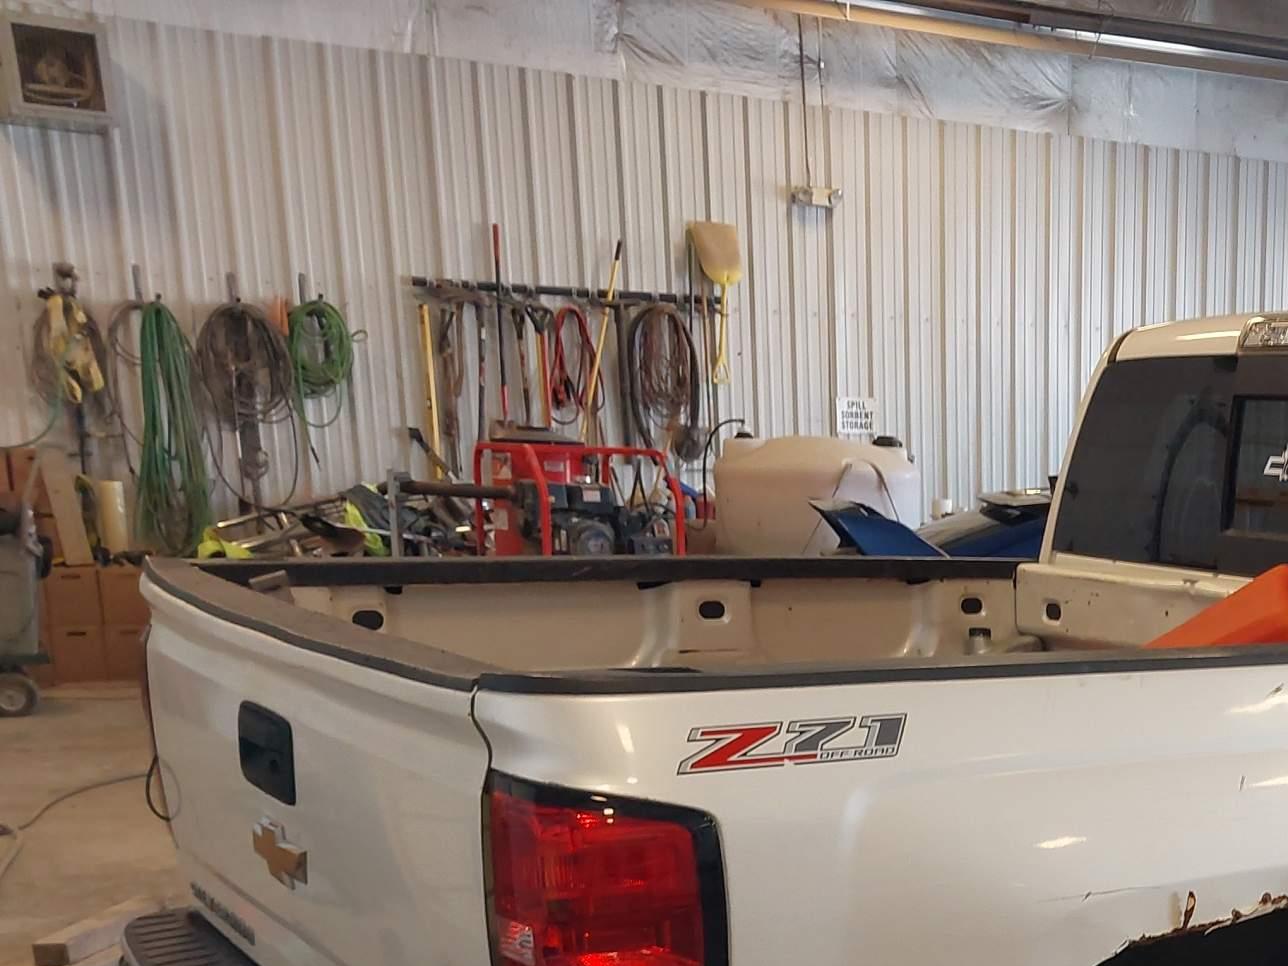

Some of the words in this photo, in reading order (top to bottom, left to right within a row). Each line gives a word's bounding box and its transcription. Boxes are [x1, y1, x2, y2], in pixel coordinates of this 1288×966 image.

[847, 400, 866, 410] SPILL
[841, 410, 873, 420] SORBENT
[841, 421, 873, 431] STORAGE
[677, 712, 907, 776] Z71
